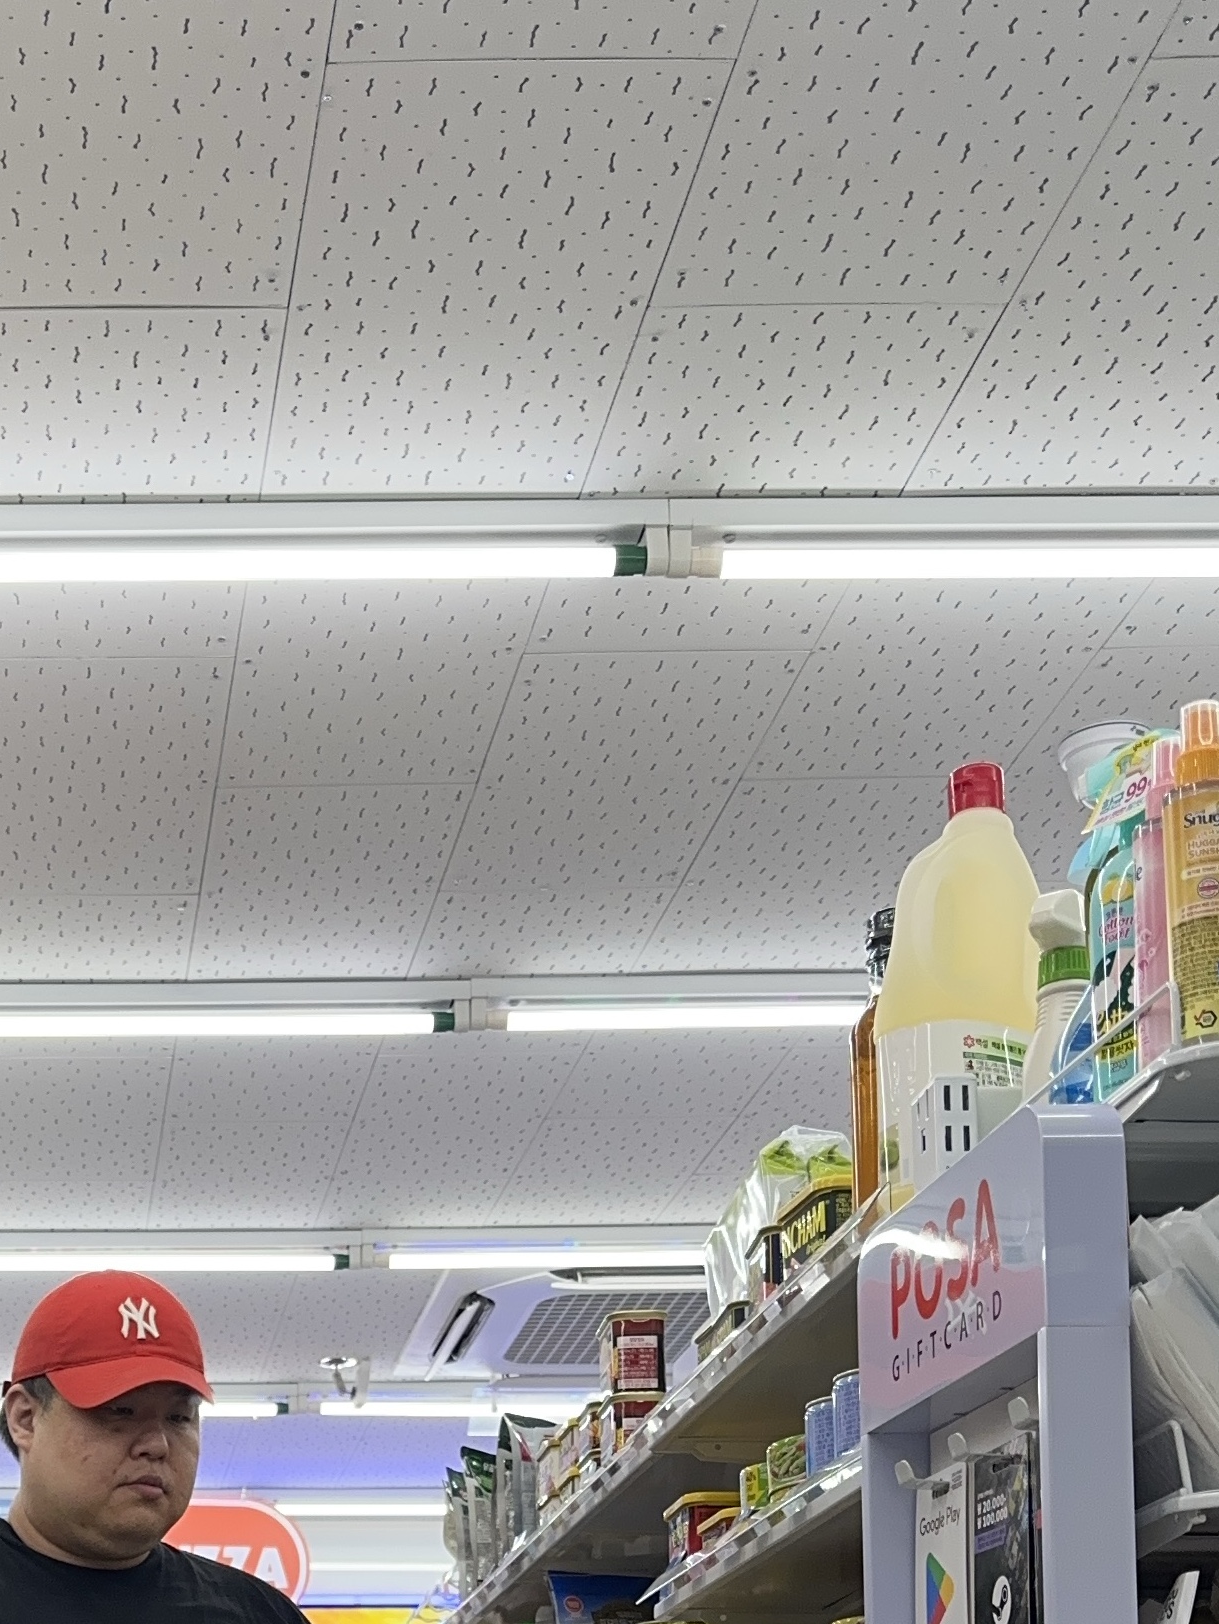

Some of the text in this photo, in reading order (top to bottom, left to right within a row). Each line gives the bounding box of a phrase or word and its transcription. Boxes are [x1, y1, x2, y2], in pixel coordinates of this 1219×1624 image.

[889, 1178, 1000, 1340] POSA
[119, 1297, 160, 1340] NY
[919, 1506, 961, 1538] Google Play
